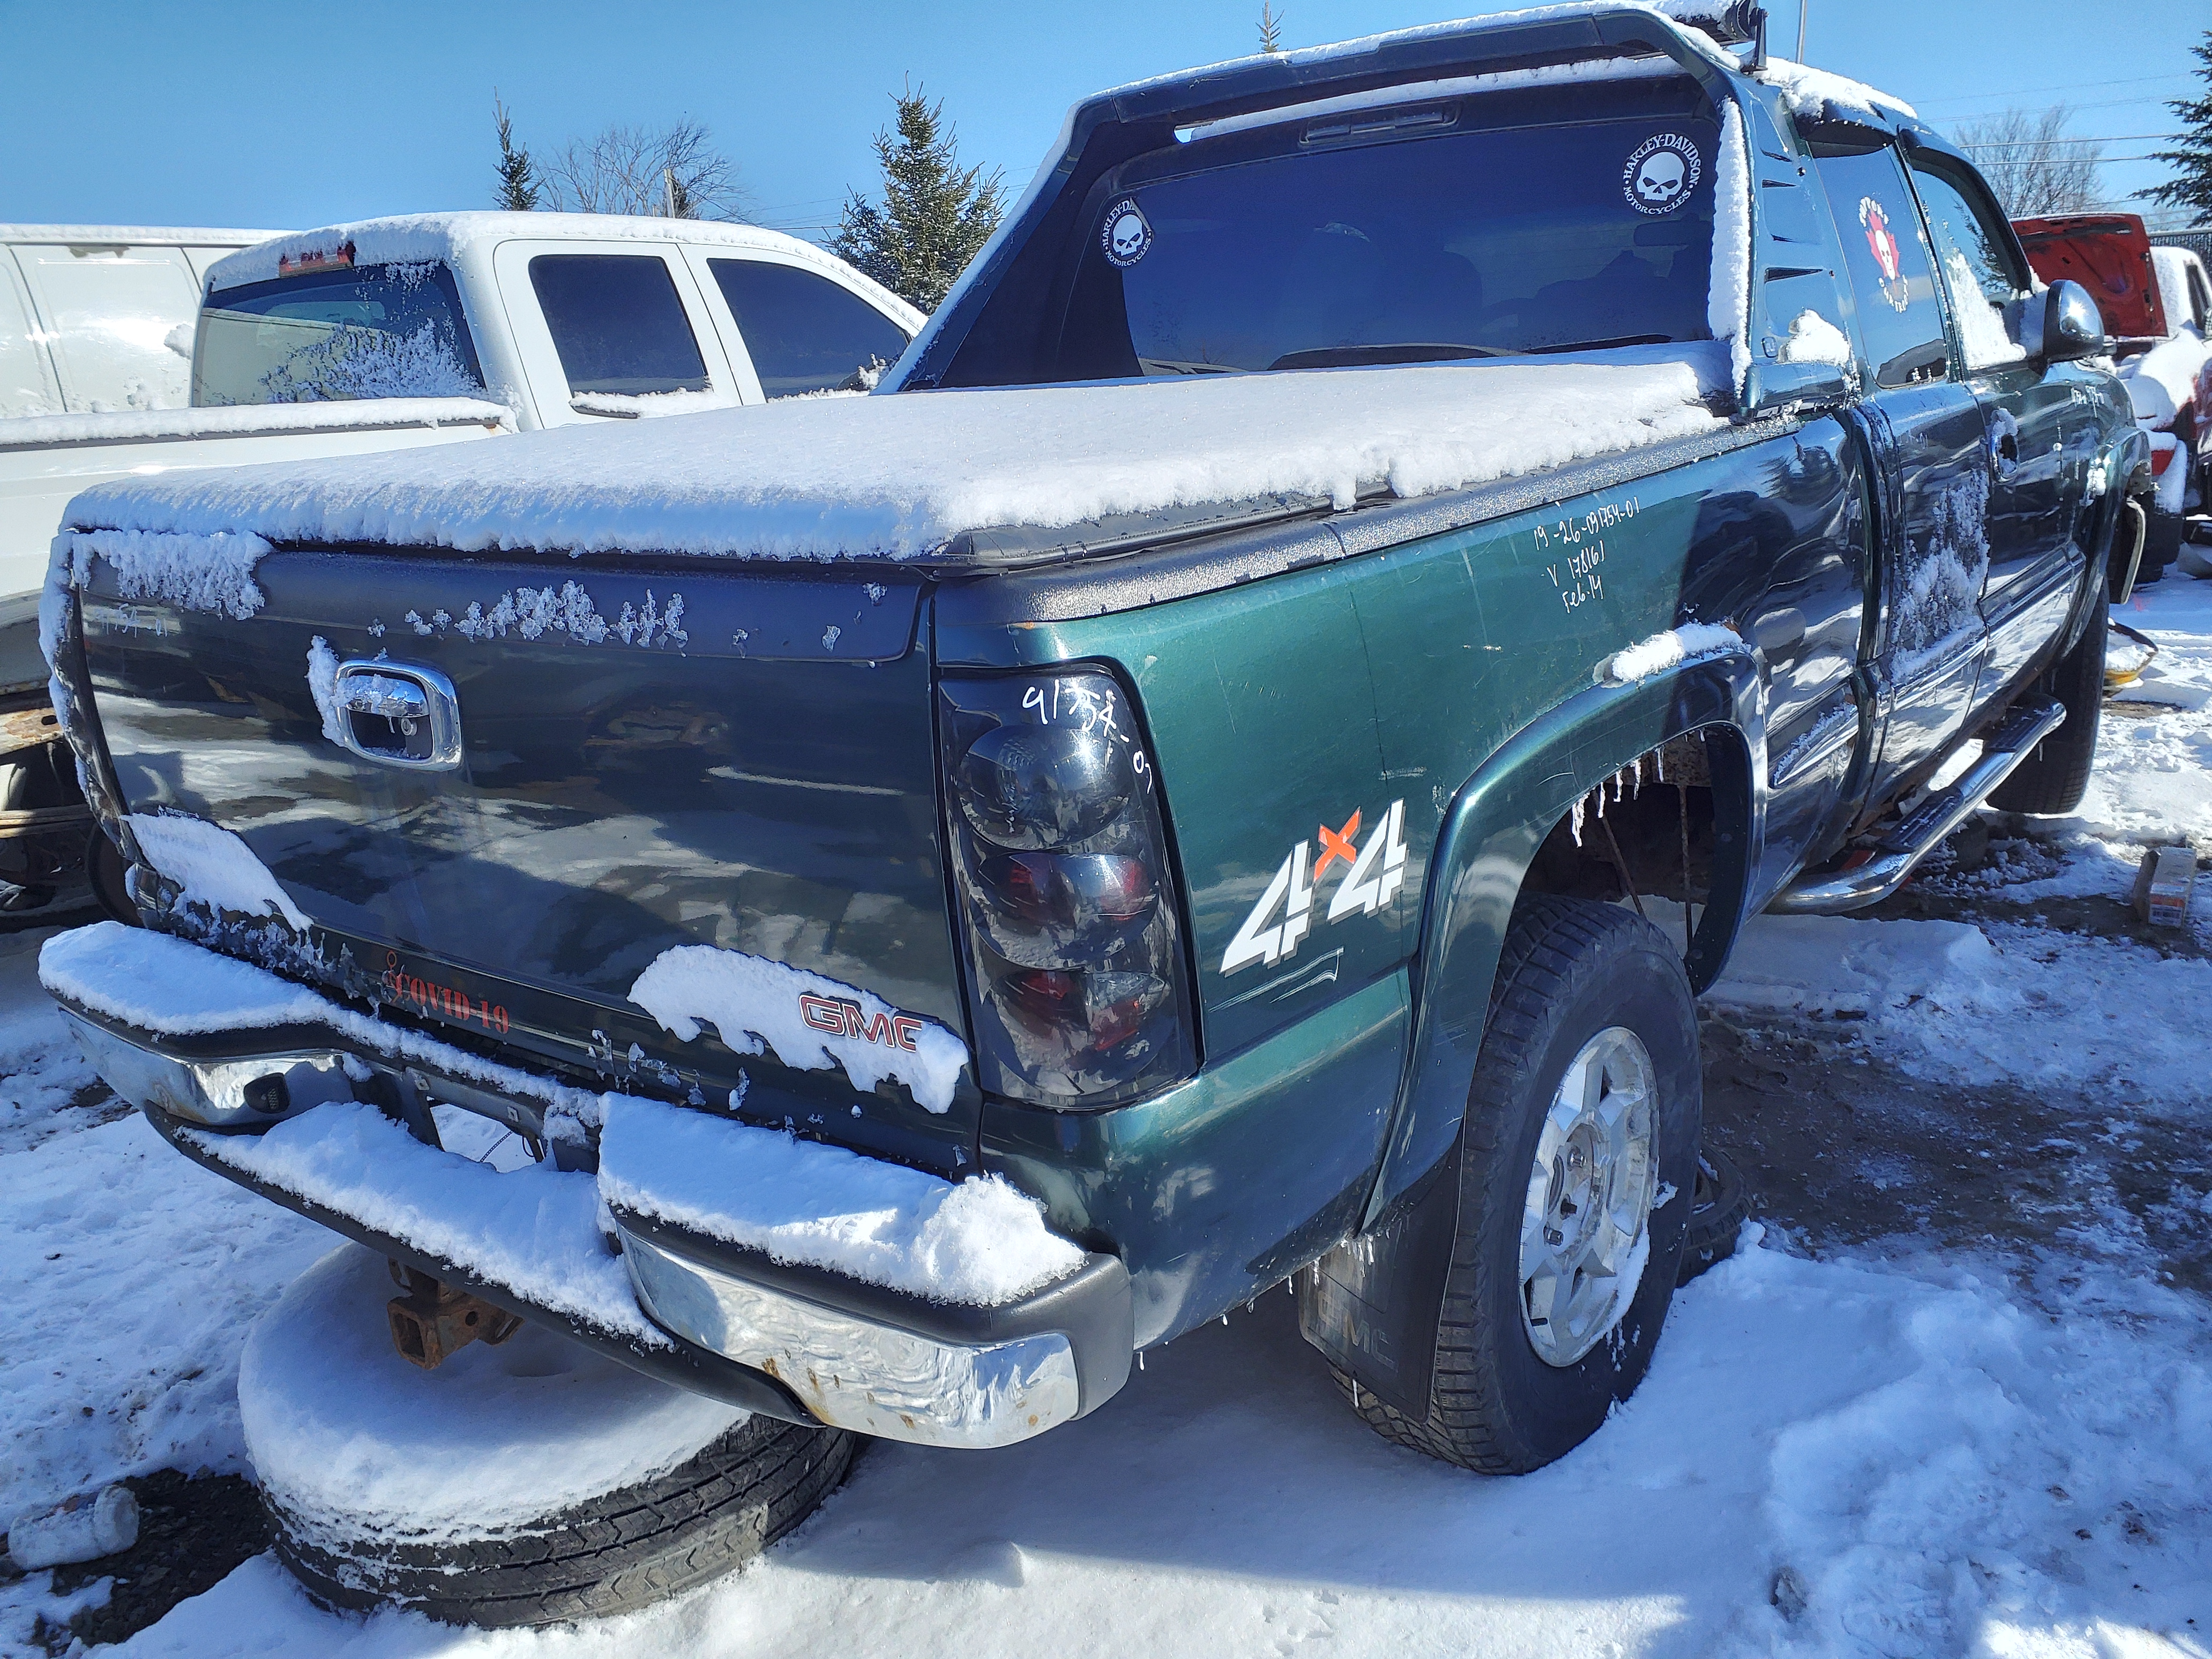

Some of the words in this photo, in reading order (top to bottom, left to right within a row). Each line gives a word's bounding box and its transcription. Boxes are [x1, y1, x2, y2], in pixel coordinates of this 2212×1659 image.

[1623, 133, 1701, 185] HARLEY-DAVIDSON
[1623, 186, 1691, 214] MOTORCYCLES
[1105, 237, 1152, 266] MOTORCYCLES
[798, 995, 922, 1053] GMC
[1318, 1290, 1399, 1373] GMC
